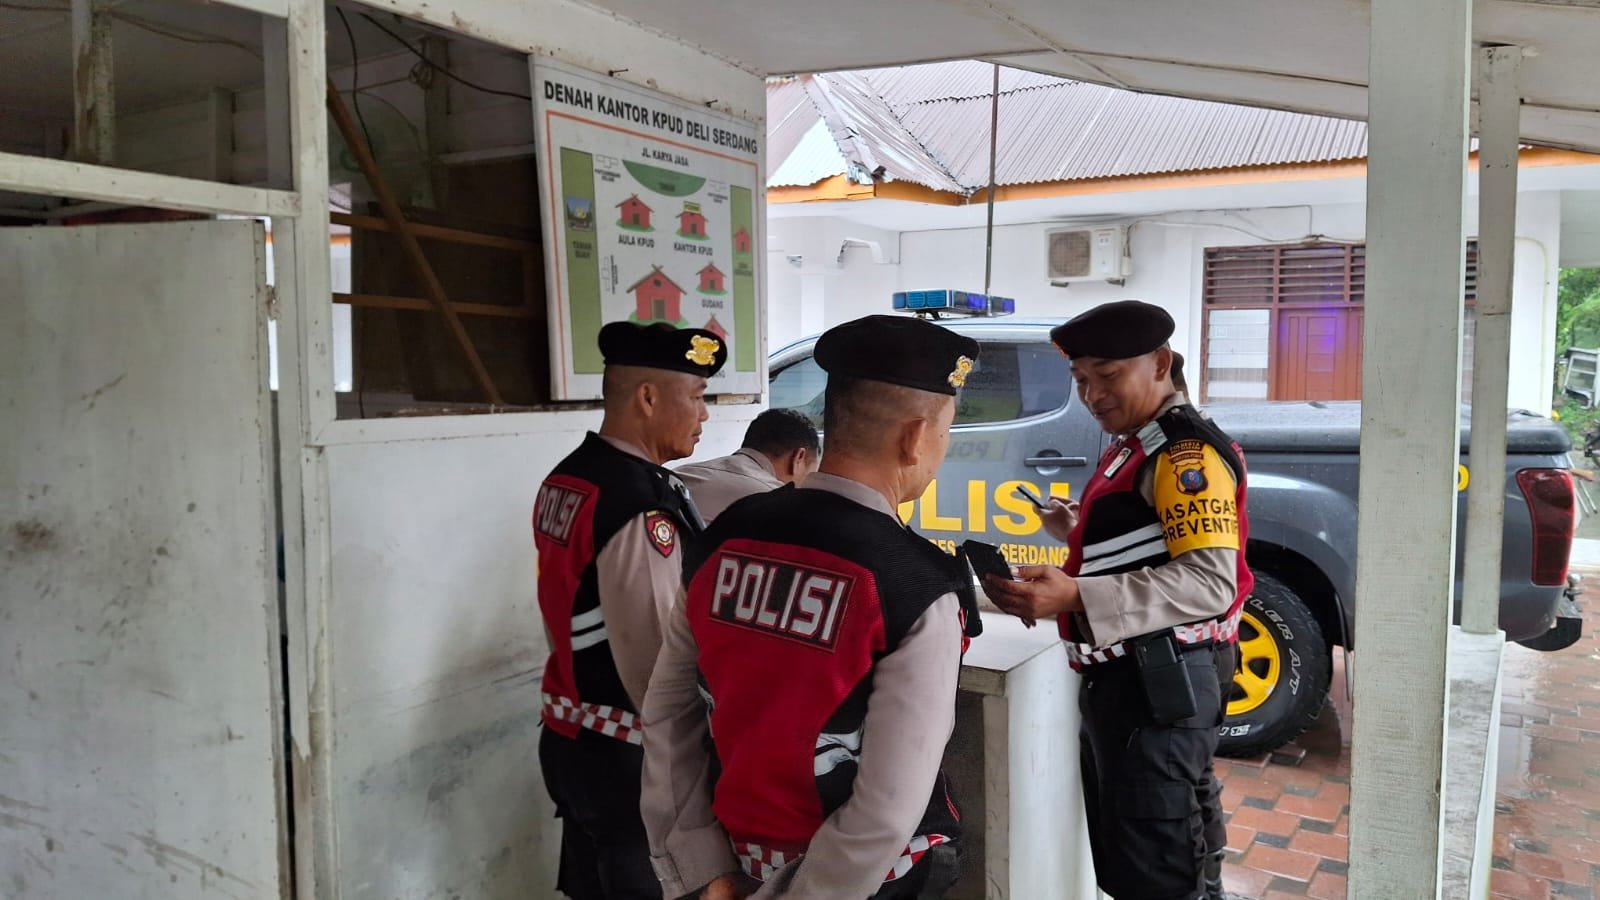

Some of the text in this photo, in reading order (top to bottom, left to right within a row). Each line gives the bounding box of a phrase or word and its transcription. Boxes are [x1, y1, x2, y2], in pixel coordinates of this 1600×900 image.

[544, 80, 758, 154] DENAH KANTOR KPUD DELI SERDANG
[652, 150, 673, 163] KARYA
[618, 234, 655, 248] AULA KPUD
[673, 242, 697, 254] KANTOR
[536, 486, 583, 541] POLISI
[1000, 543, 1070, 567] SERDANG
[712, 558, 846, 641] POLISI
